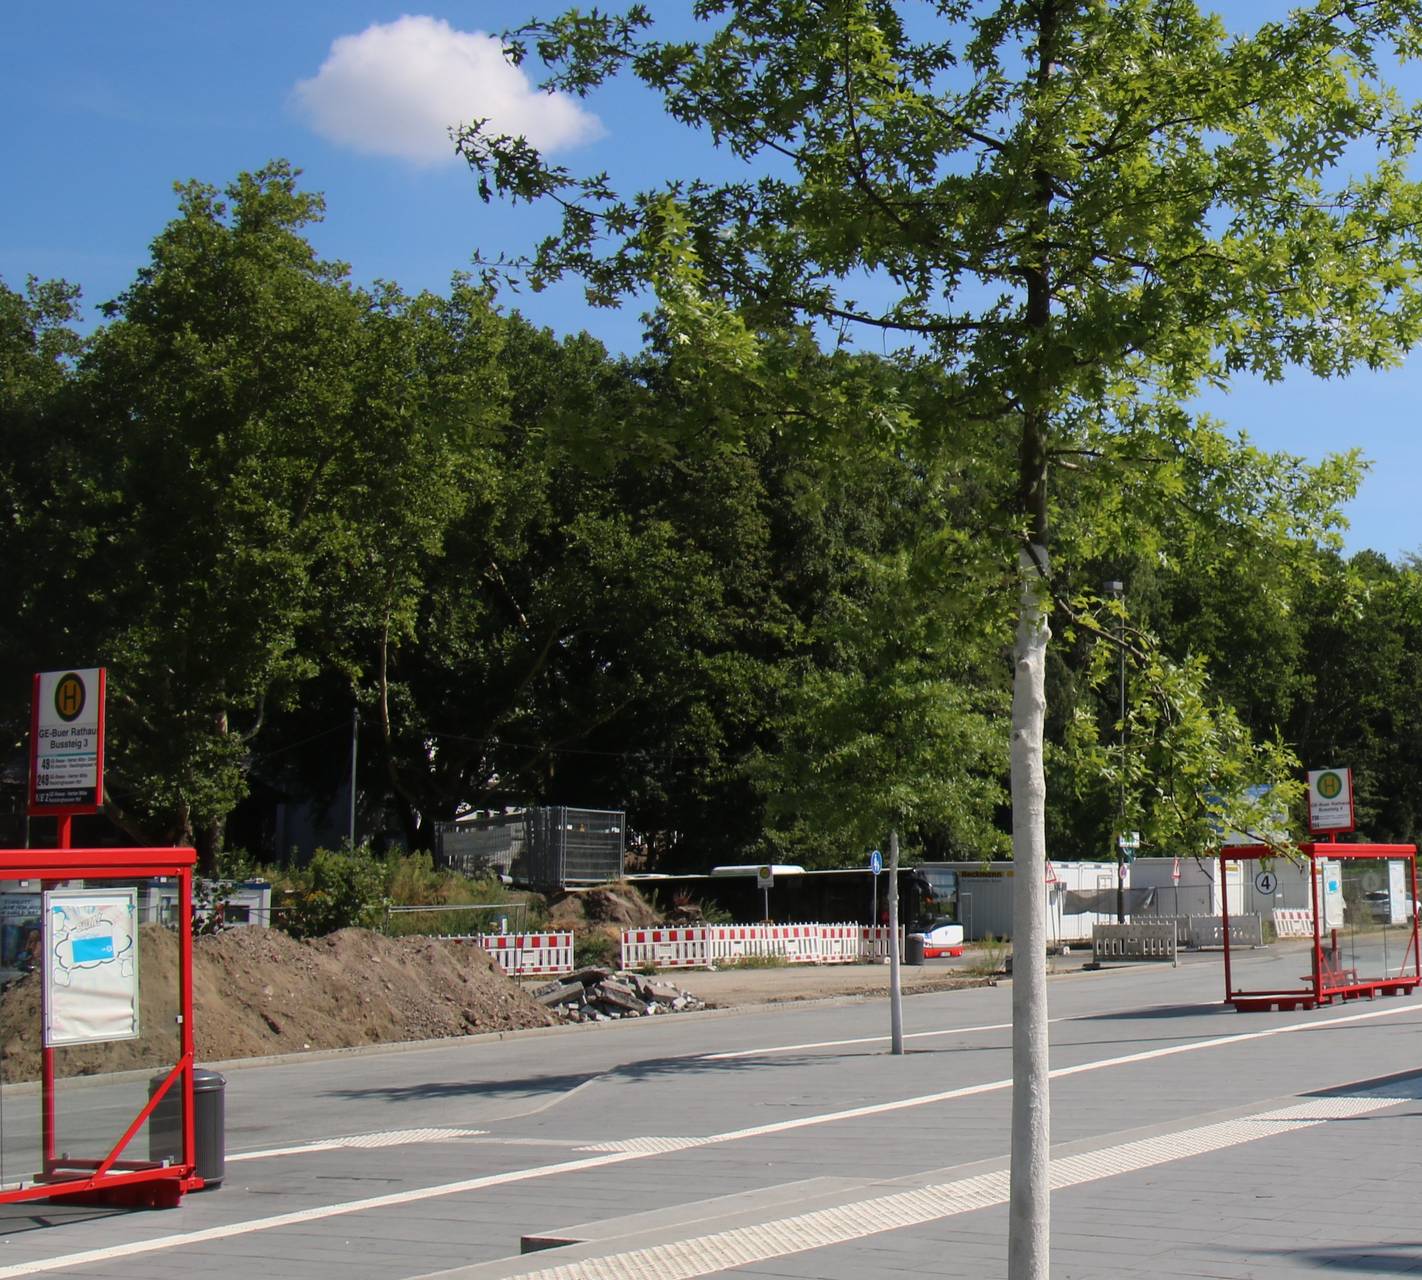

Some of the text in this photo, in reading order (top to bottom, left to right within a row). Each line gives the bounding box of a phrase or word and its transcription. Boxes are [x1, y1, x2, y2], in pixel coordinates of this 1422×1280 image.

[63, 684, 76, 711] H
[71, 727, 97, 736] Rathau
[50, 738, 89, 749] Bussteig 3
[1261, 875, 1271, 890] 4
